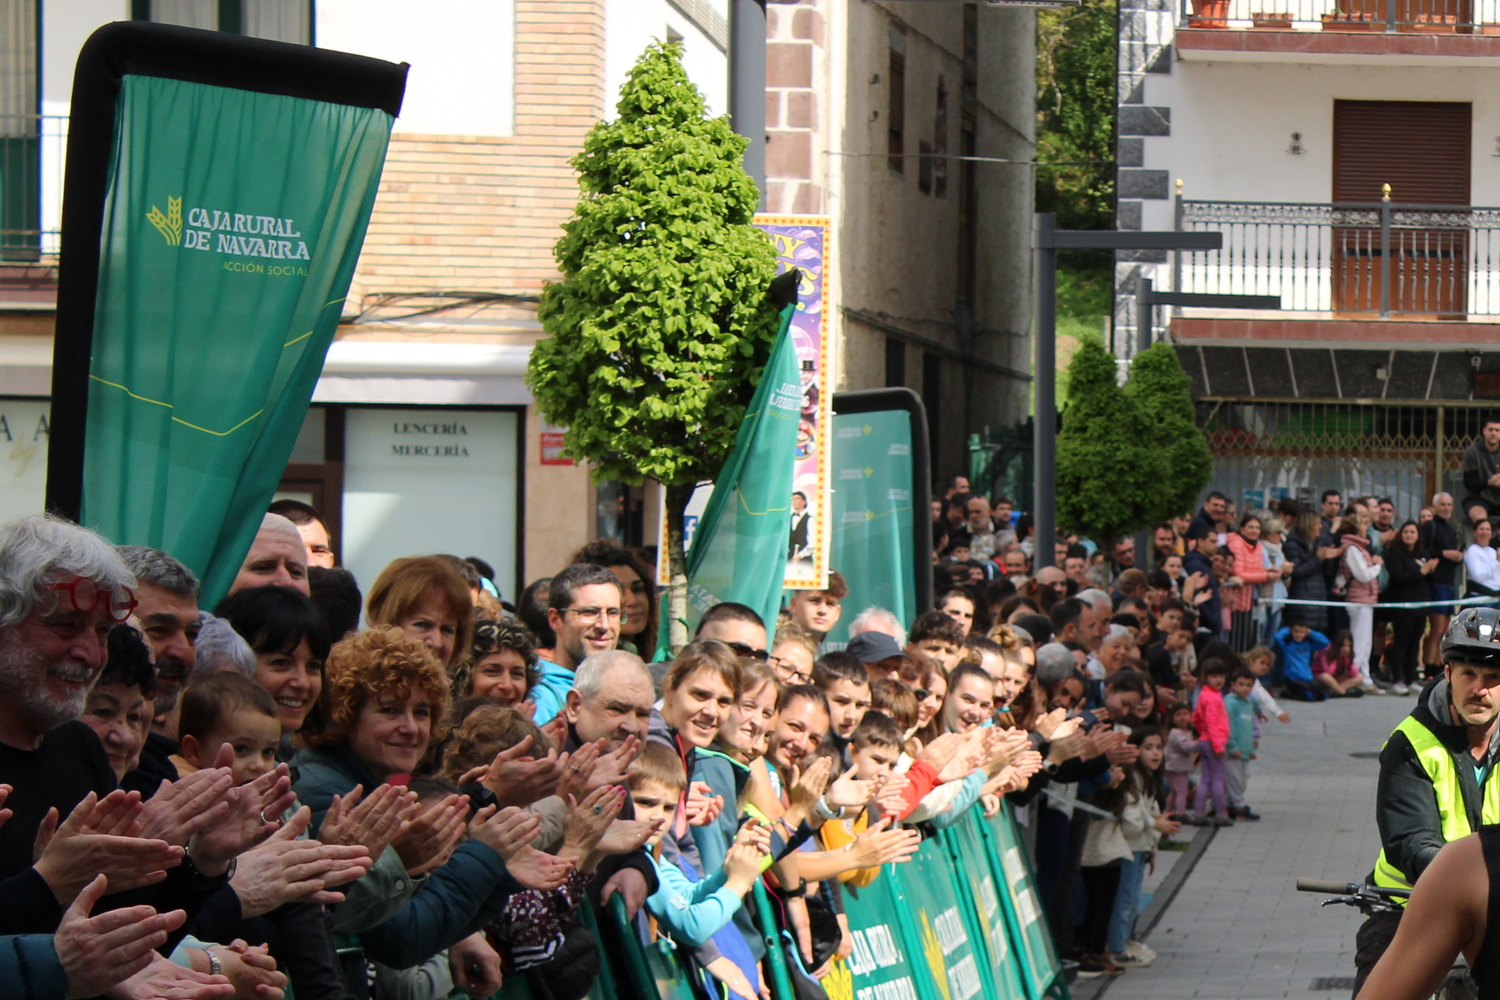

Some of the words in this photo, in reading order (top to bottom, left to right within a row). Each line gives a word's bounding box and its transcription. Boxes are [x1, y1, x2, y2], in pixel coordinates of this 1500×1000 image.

[188, 207, 231, 232] CAJA
[234, 212, 300, 238] RURAL
[184, 229, 211, 251] DE
[216, 233, 310, 260] NAVARRA
[222, 261, 264, 274] ACCIÓN
[267, 266, 308, 277] SOCIAL
[394, 421, 468, 435] LENCERÍA
[392, 444, 470, 456] MERCERÍA
